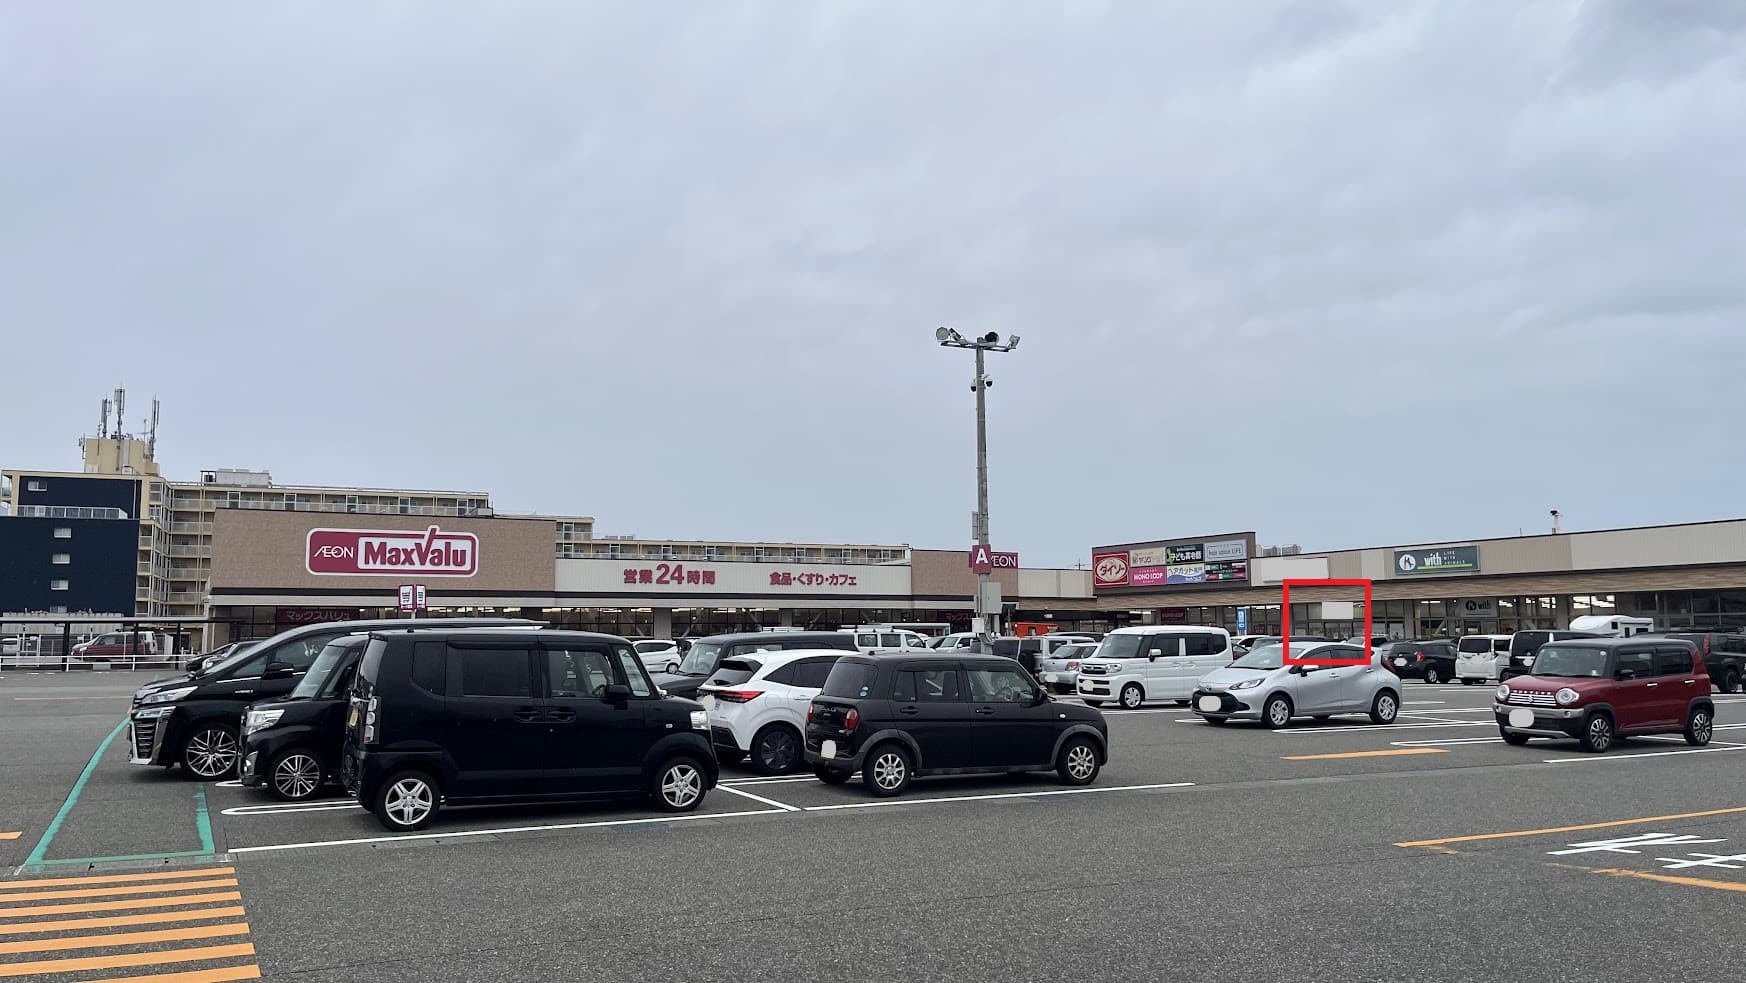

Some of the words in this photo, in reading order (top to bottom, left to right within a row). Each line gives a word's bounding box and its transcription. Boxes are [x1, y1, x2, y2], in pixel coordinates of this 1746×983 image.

[364, 528, 467, 567] MaxValu
[976, 549, 988, 564] A
[991, 555, 1016, 567] EON
[1424, 552, 1442, 566] with
[623, 563, 716, 585] 営業24時間
[1100, 564, 1125, 576] ダイソー
[769, 571, 857, 586] 食品・くすり・カフェ
[285, 610, 353, 621] マックスバリュ
